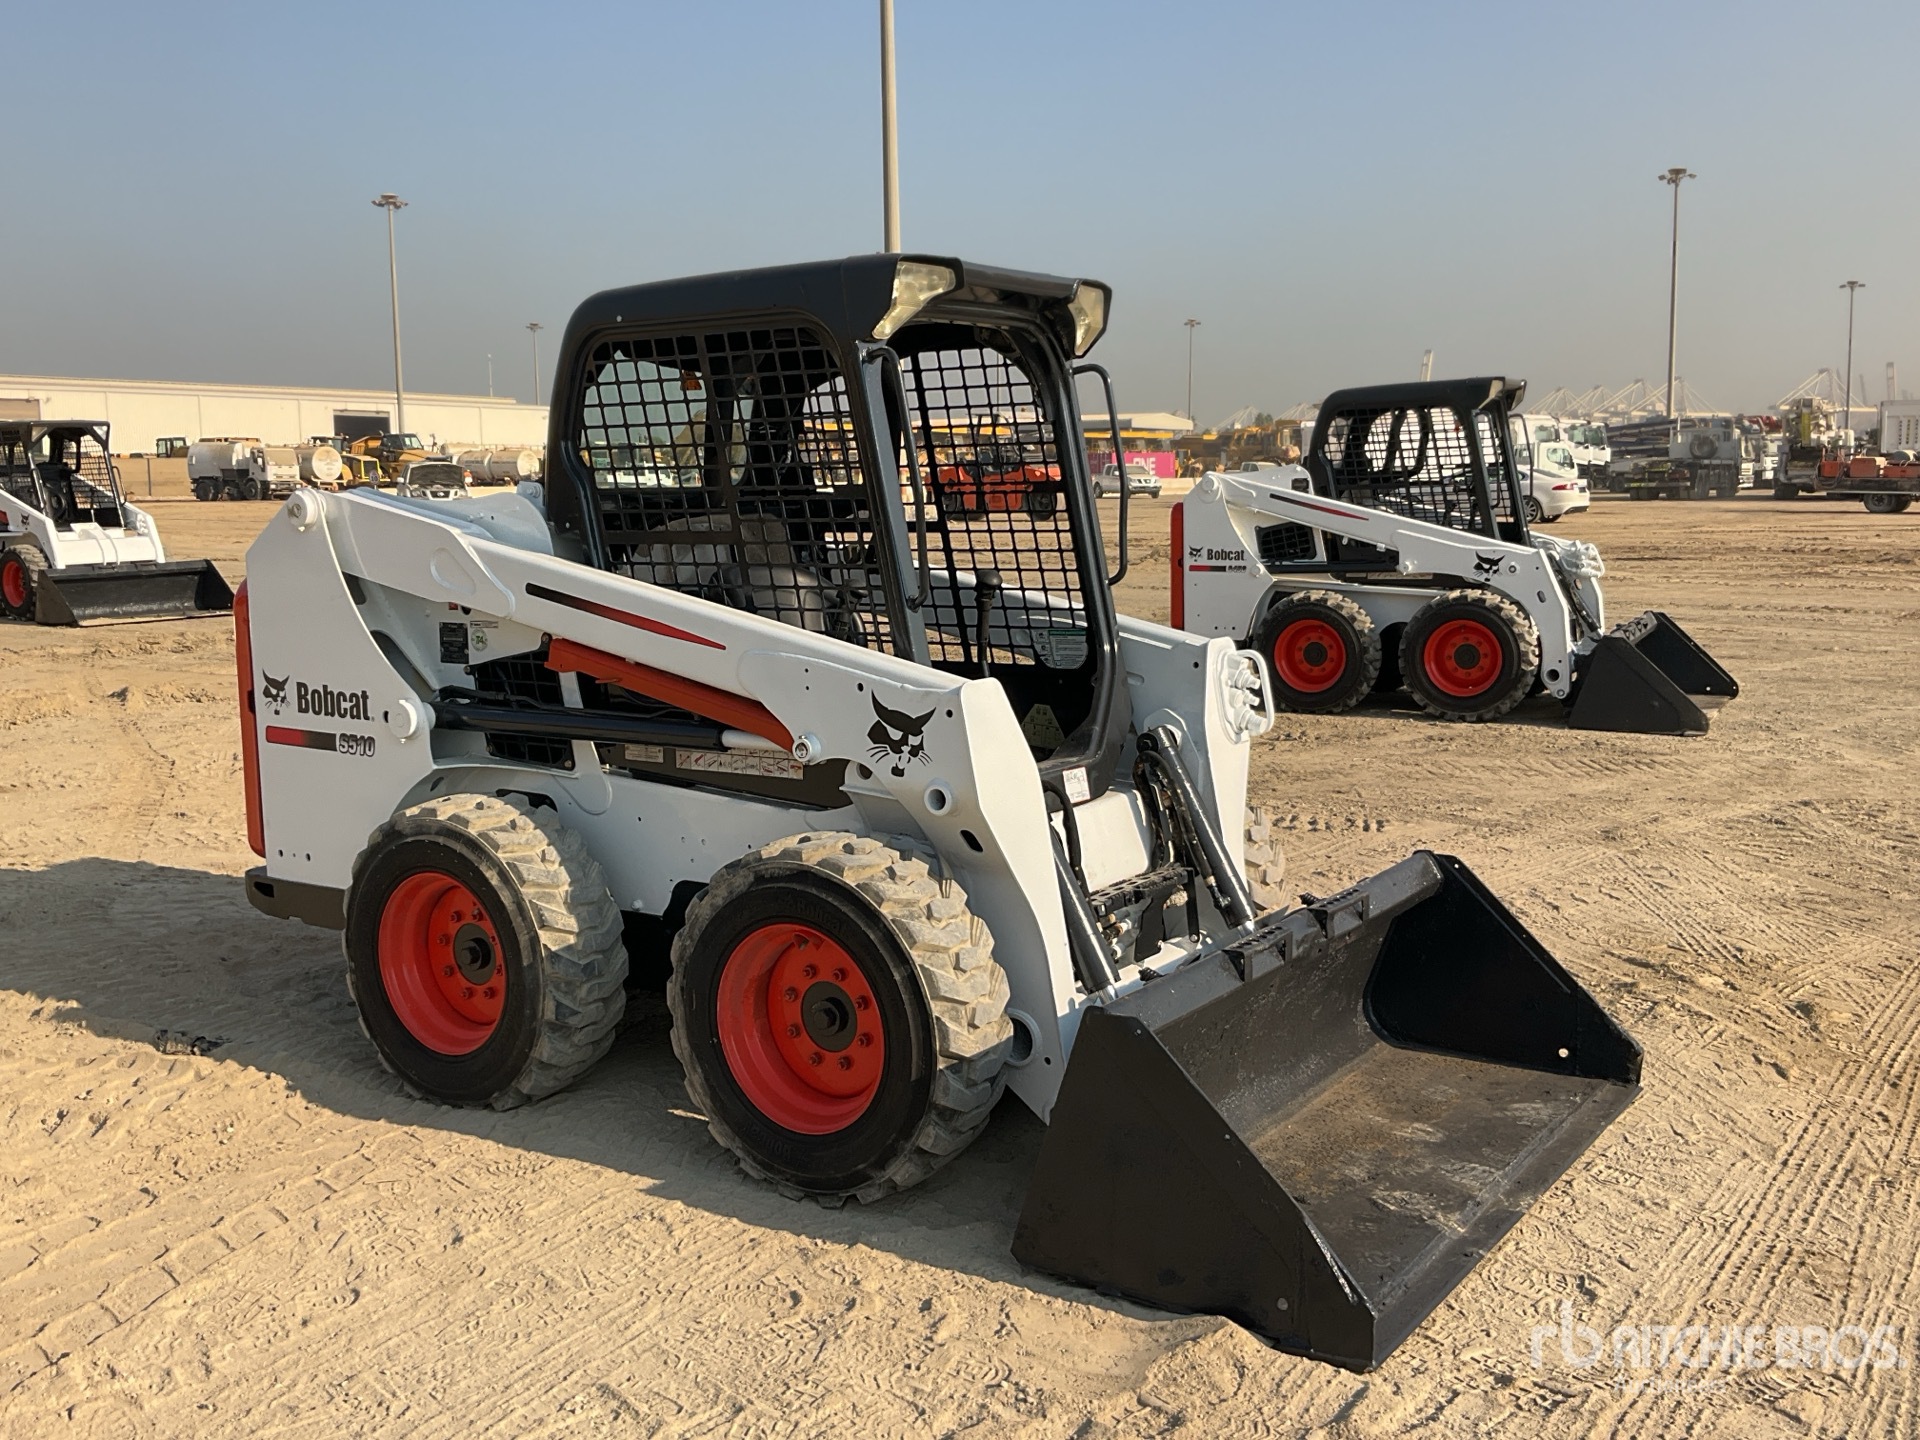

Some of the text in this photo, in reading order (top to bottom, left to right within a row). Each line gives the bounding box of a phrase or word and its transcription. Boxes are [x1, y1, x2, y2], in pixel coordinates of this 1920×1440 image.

[1207, 548, 1245, 561] Bobcat
[296, 681, 371, 721] Bobcat
[338, 732, 376, 758] S510
